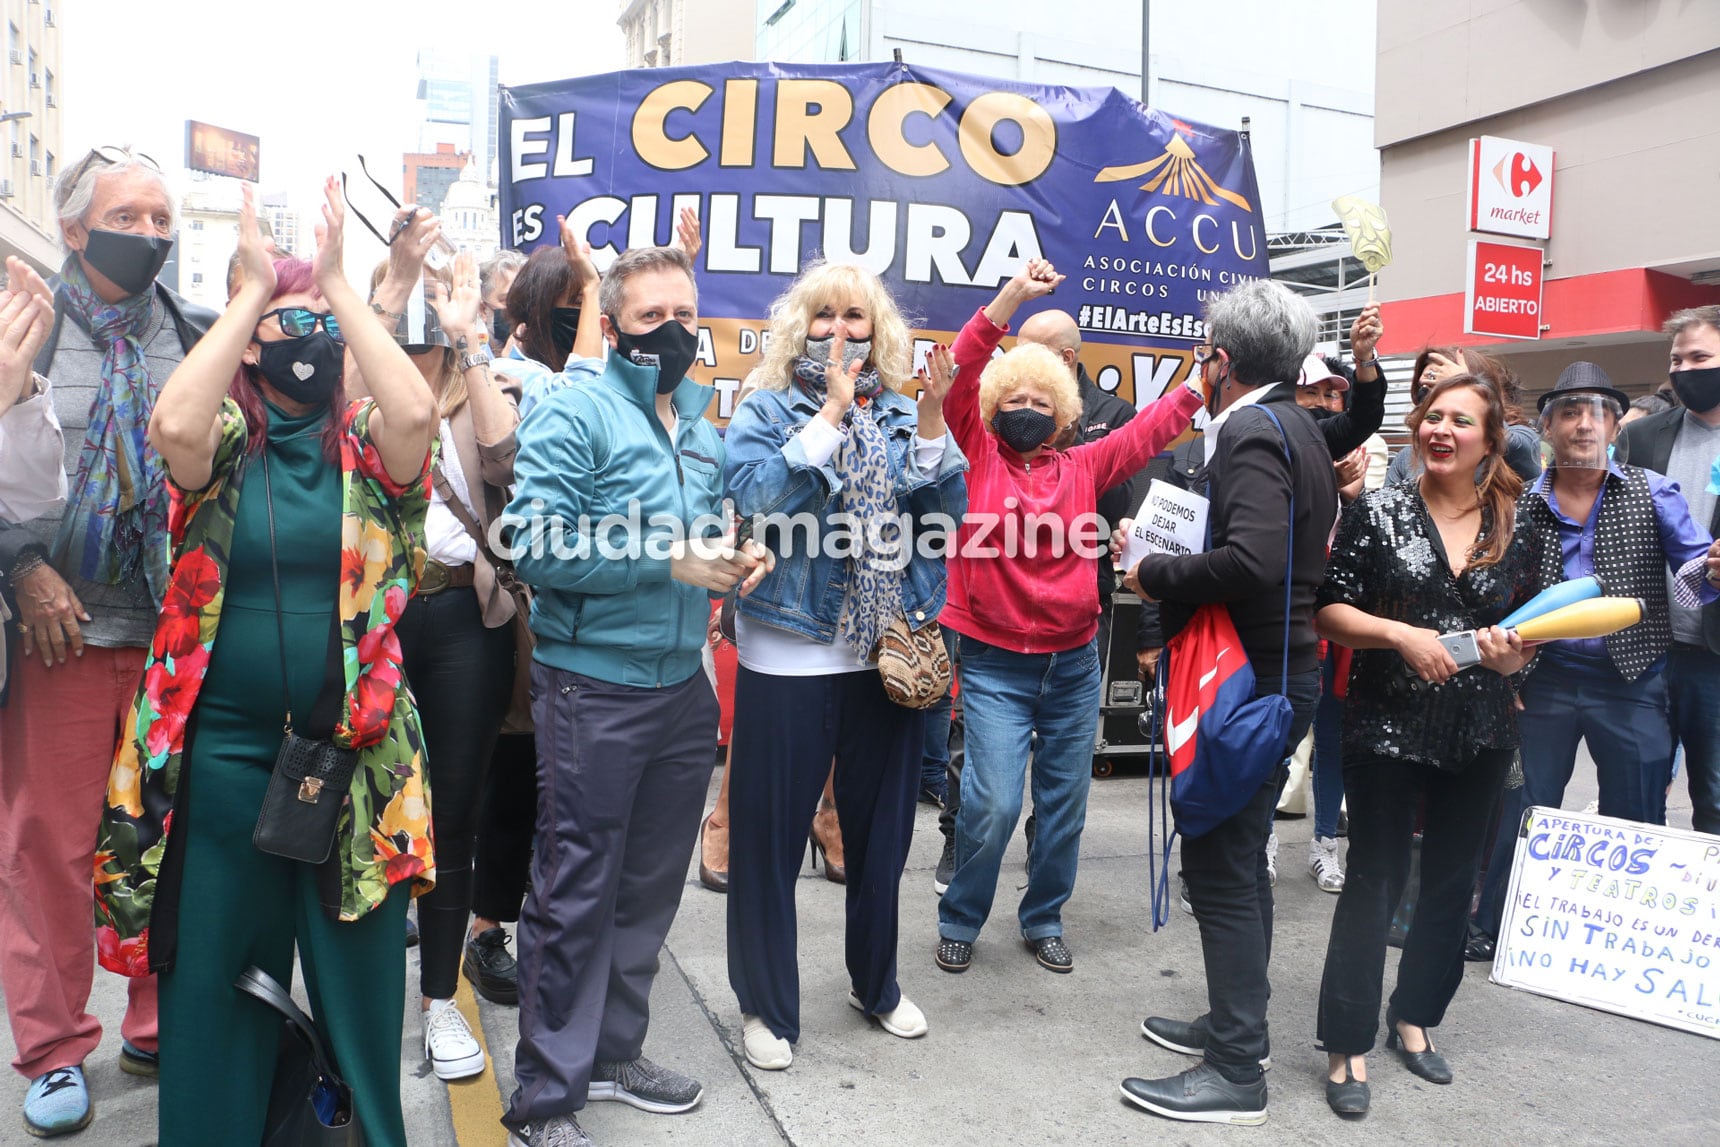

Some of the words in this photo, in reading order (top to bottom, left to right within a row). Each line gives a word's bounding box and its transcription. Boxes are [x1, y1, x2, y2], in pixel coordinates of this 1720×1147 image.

[511, 111, 595, 184] EL
[631, 79, 1057, 186] CIRCO
[1489, 206, 1541, 226] market
[513, 203, 544, 247] ES
[561, 193, 1047, 289] CULTURA
[1094, 198, 1258, 261] ACCU
[1083, 255, 1212, 281] ASOCIACIÓN
[1483, 262, 1508, 284] 24
[1511, 264, 1533, 287] hs
[1082, 277, 1169, 298] CIRCOS
[1474, 295, 1538, 316] ABIERTO
[1158, 497, 1196, 522] PODEMOS
[1134, 526, 1144, 539] EL
[1151, 513, 1177, 535] DEJAR
[1536, 818, 1626, 840] APERTURA
[1569, 869, 1699, 916] TEATROS
[1632, 918, 1649, 931] ES
[1654, 925, 1678, 938] UN
